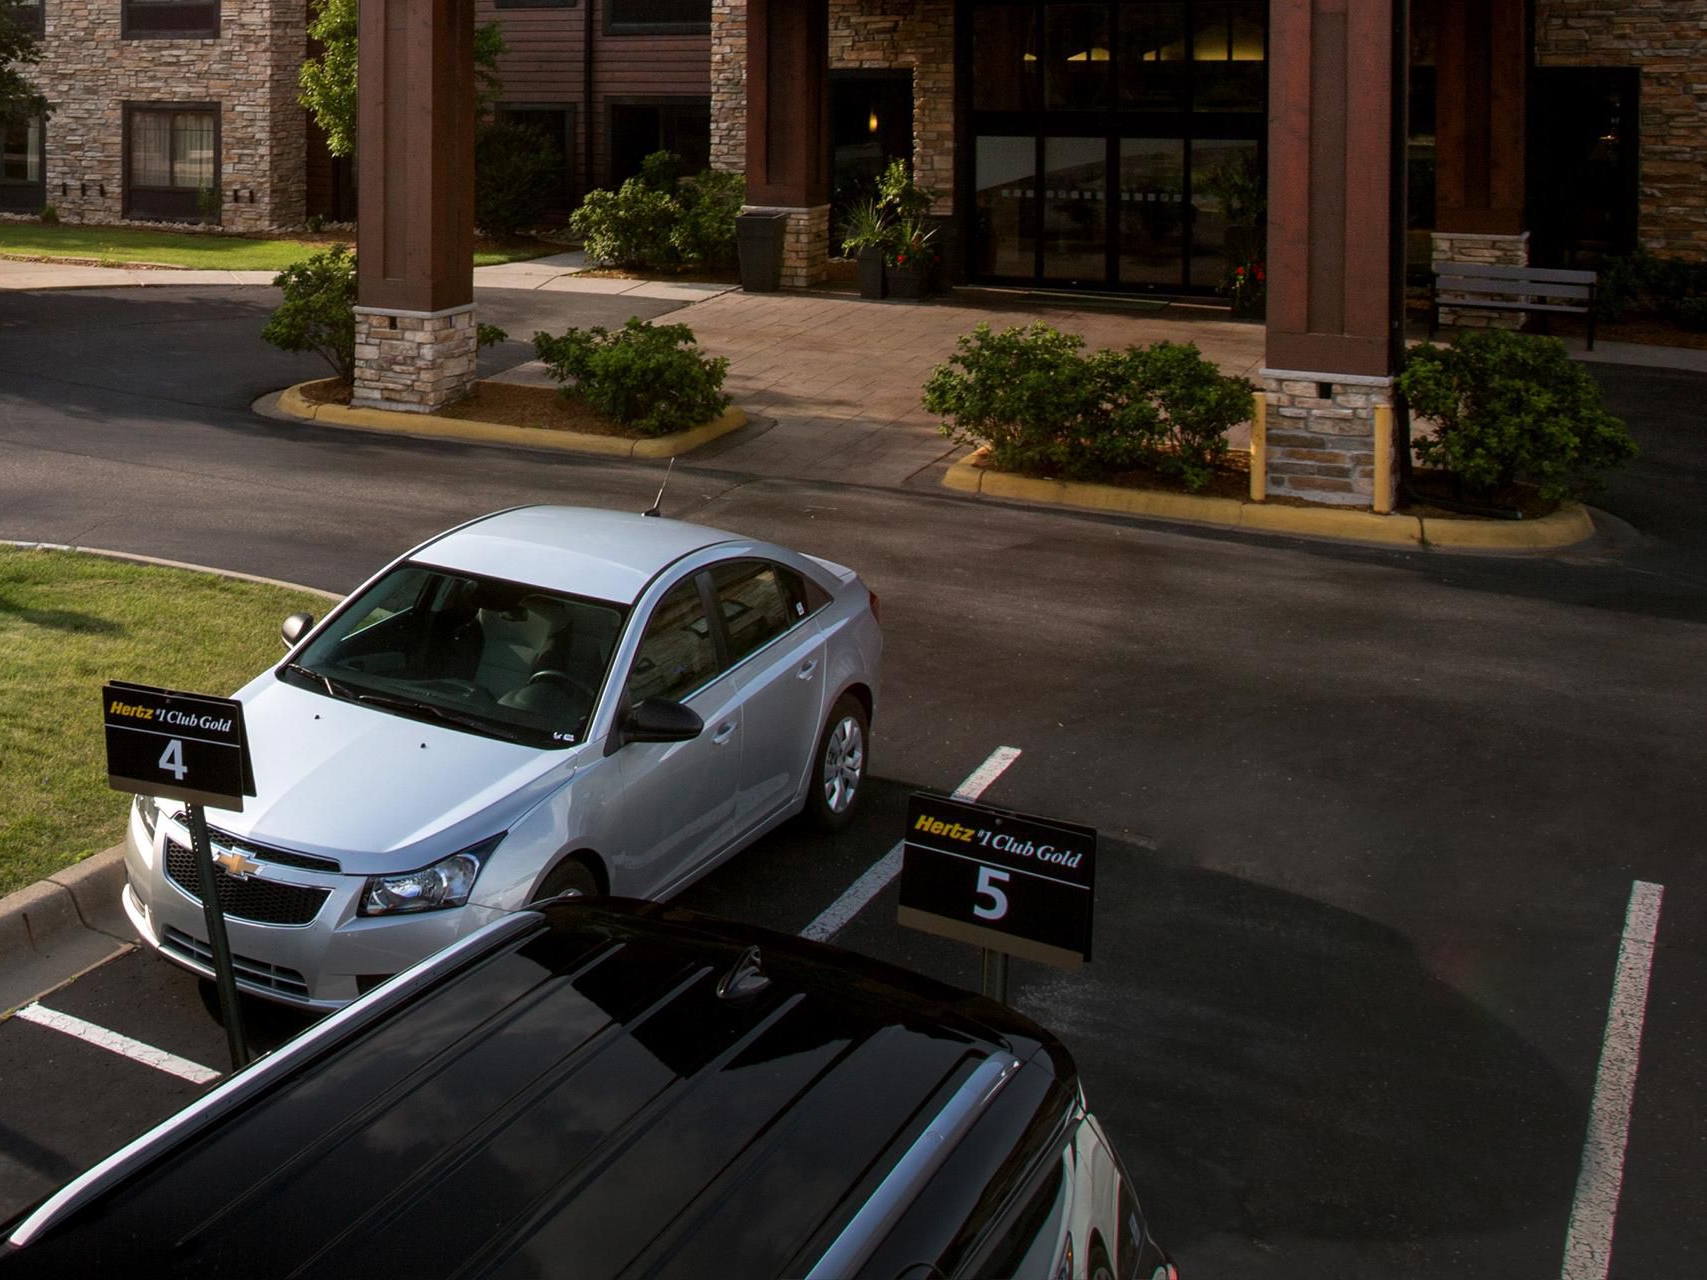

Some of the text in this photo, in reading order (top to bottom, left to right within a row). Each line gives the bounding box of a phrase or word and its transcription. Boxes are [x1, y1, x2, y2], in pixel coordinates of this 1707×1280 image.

[110, 701, 154, 719] Hertz
[167, 710, 198, 727] Club
[199, 715, 232, 732] Gold
[158, 739, 188, 781] 4
[914, 815, 976, 842] Hertz
[992, 834, 1035, 857] Club
[1036, 845, 1083, 868] Gold
[973, 865, 1011, 920] 5
